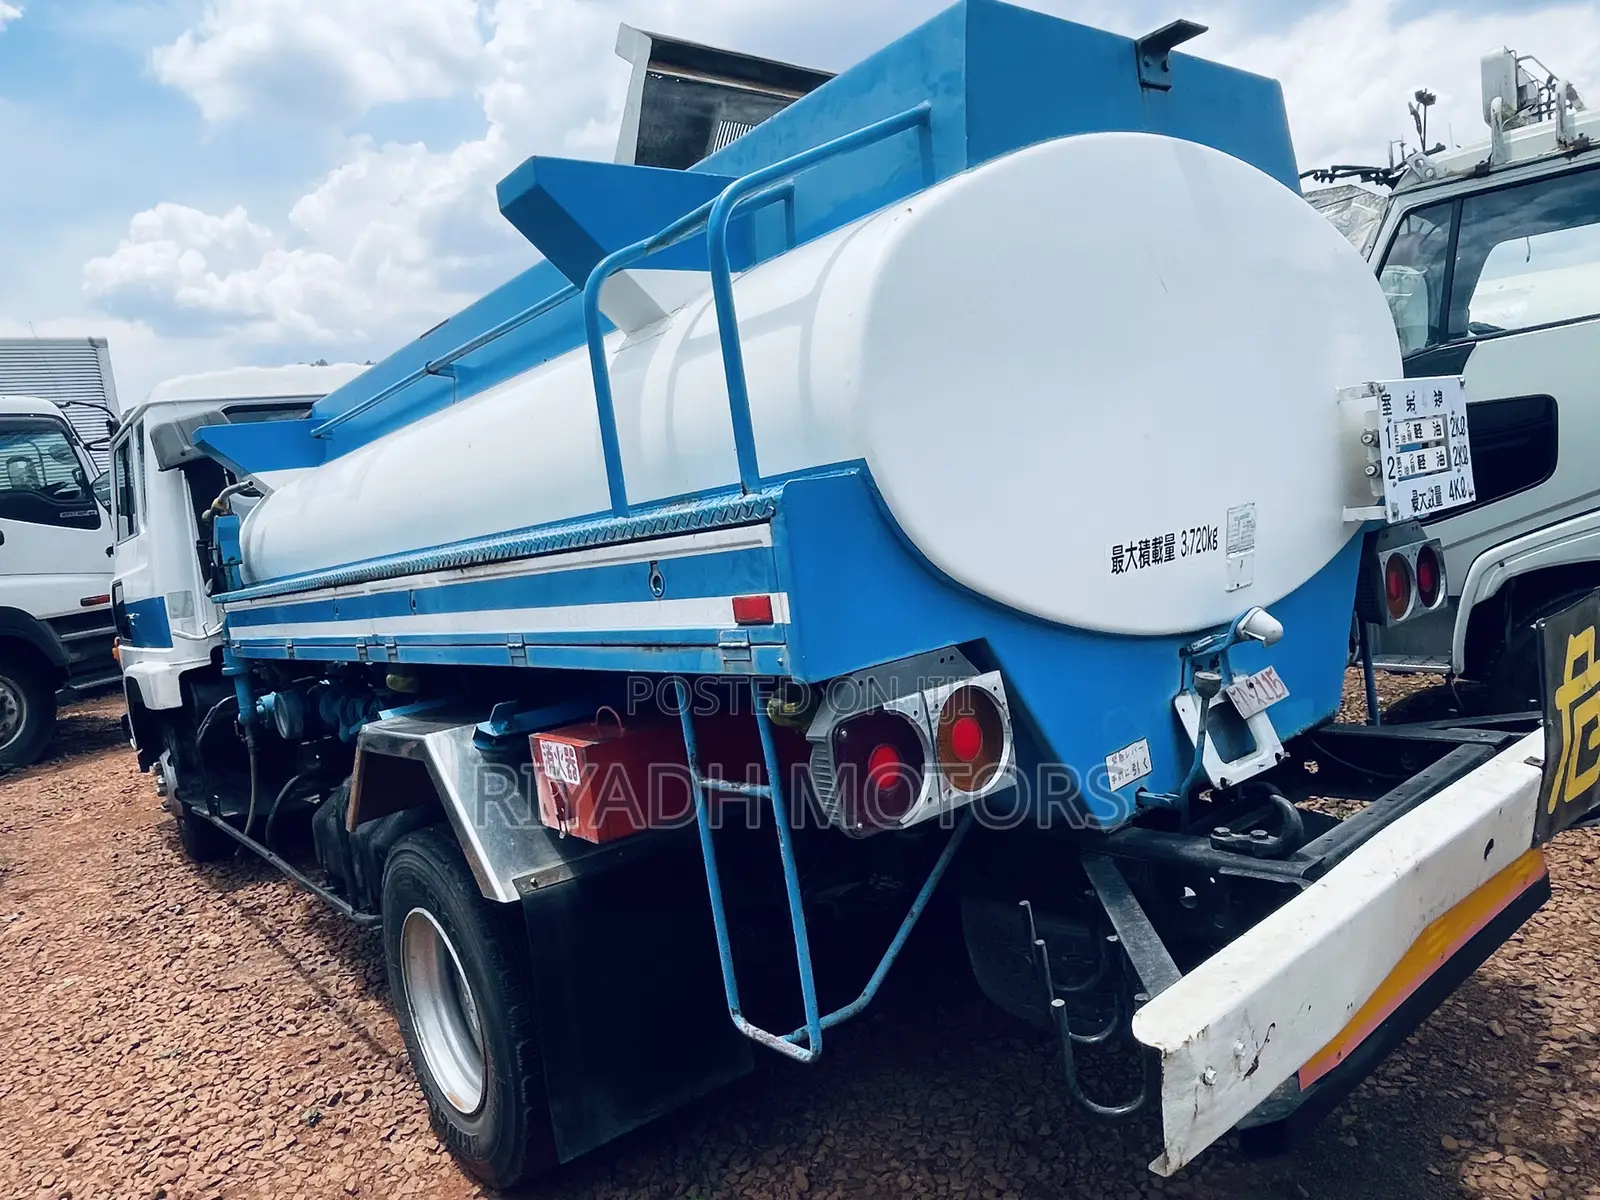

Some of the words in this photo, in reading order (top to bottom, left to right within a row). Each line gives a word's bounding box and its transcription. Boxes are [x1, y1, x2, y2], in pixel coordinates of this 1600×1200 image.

[1387, 455, 1396, 480] 2
[1111, 532, 1176, 575] 最大積載量
[541, 742, 578, 781] 消火器
